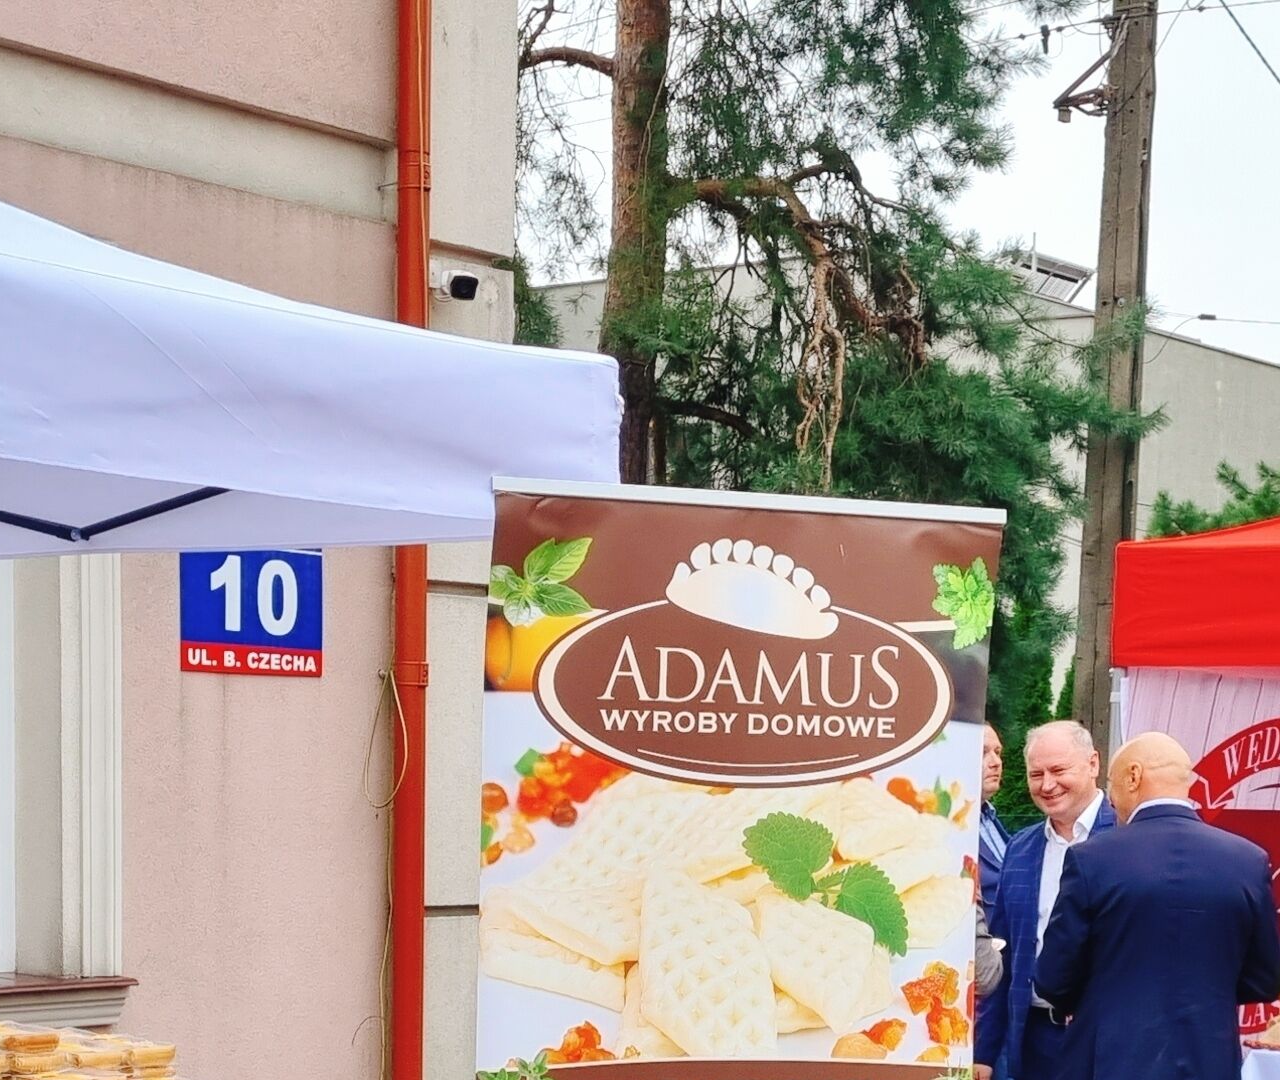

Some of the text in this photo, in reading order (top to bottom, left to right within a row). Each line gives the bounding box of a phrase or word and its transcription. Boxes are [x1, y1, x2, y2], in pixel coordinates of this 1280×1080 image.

[210, 554, 298, 636] 10
[187, 647, 317, 673] UL. B. CZECHA
[596, 635, 900, 710] ADAMUS
[599, 708, 896, 739] WYROBY DOMOWE
